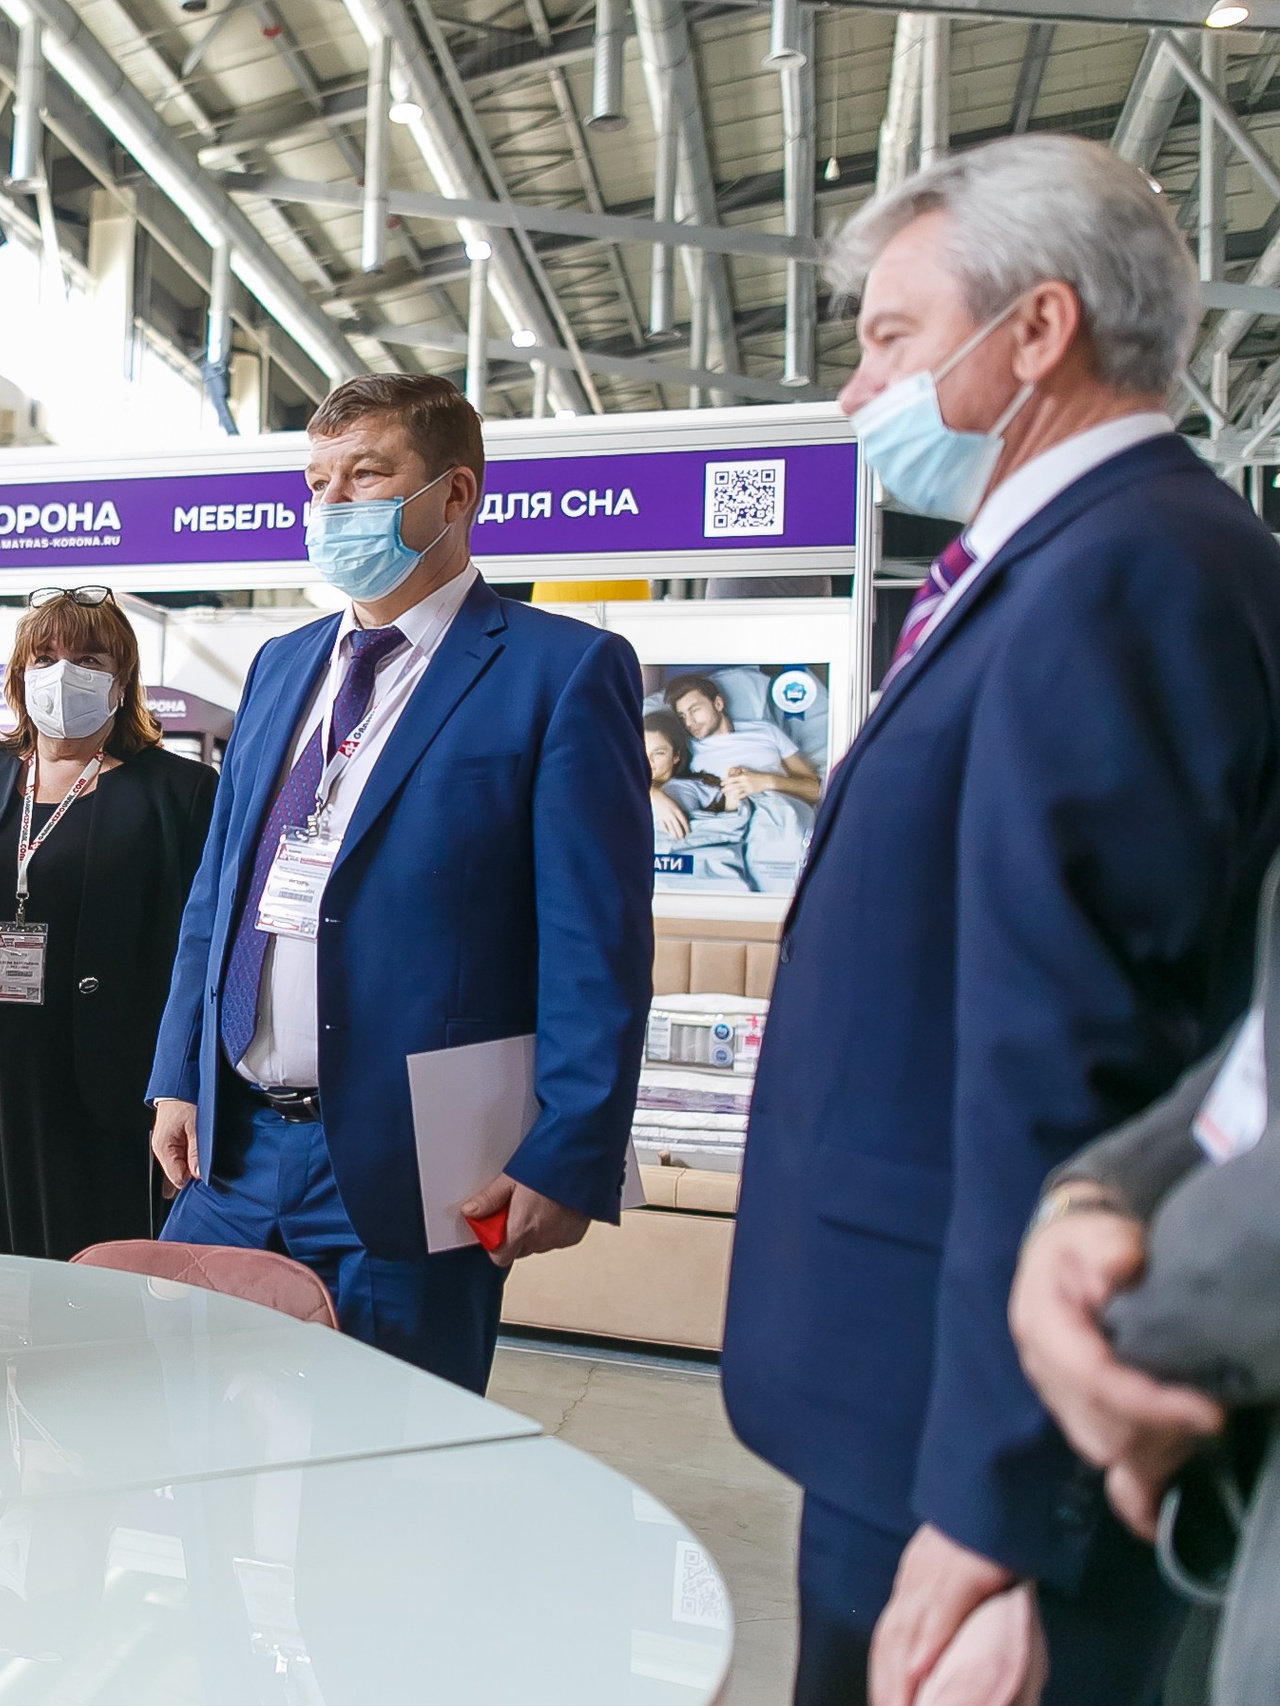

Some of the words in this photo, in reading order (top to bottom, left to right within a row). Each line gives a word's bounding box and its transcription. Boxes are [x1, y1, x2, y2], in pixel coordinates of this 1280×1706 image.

[174, 503, 296, 532] МЕБЕЛЬ
[477, 491, 552, 524] ДЛЯ
[560, 488, 639, 517] СНА
[654, 856, 683, 871] АТИ
